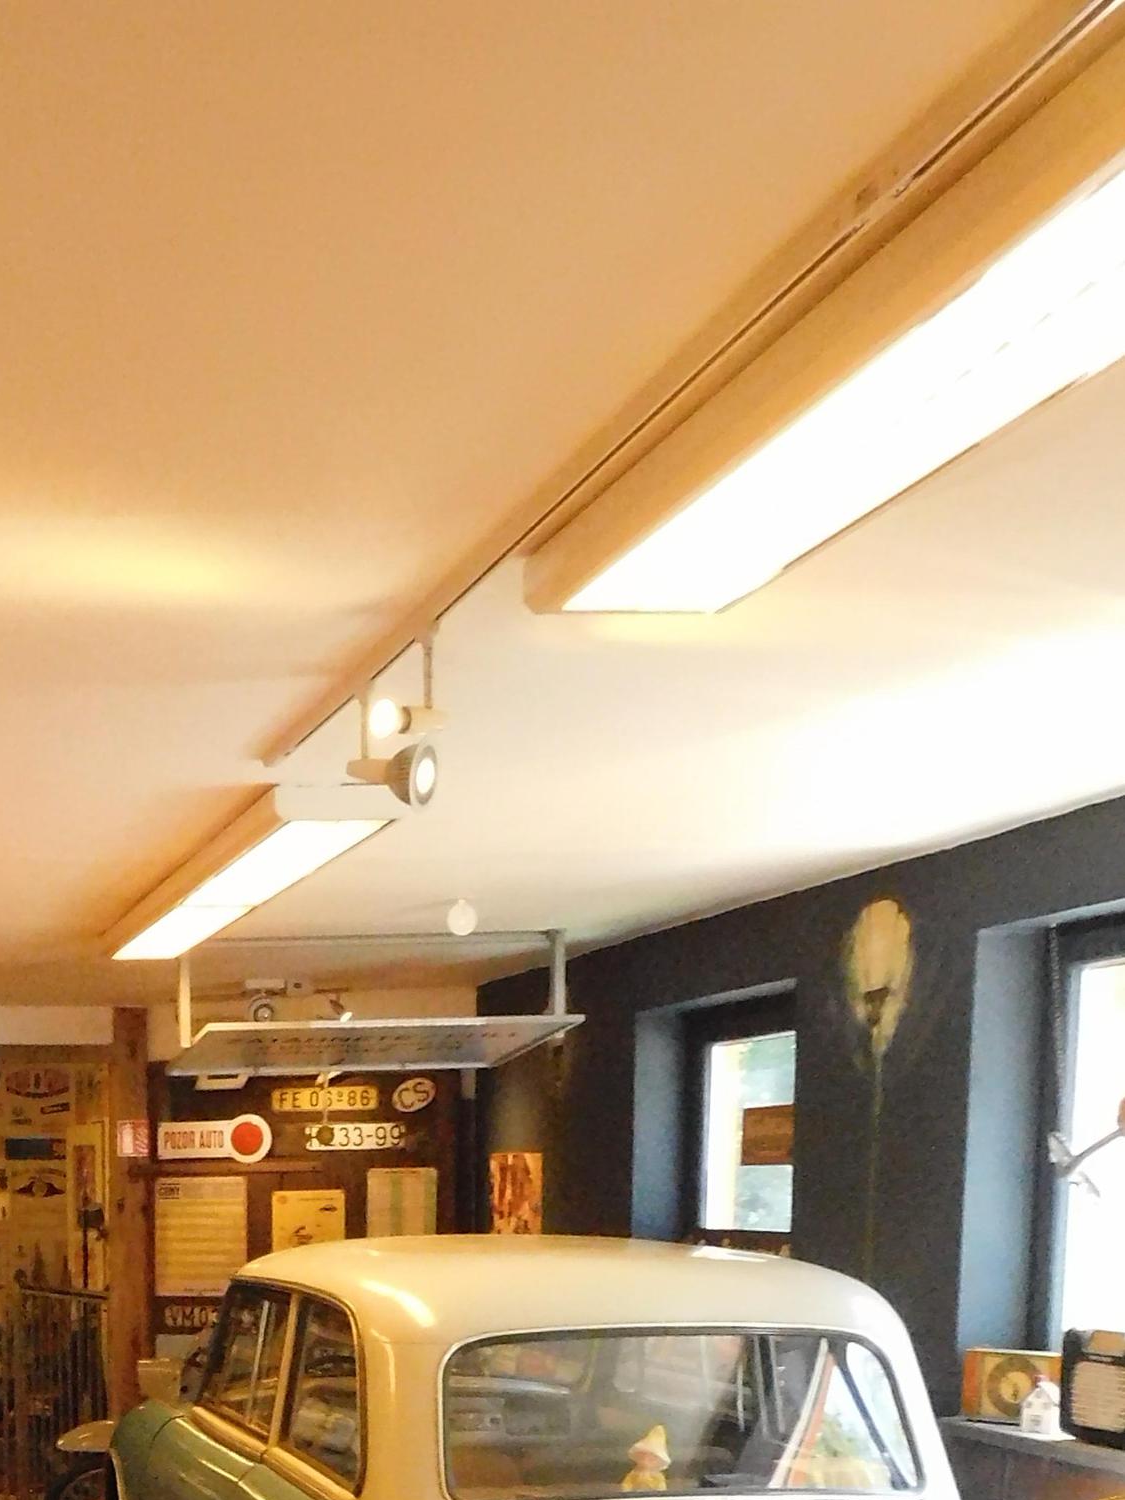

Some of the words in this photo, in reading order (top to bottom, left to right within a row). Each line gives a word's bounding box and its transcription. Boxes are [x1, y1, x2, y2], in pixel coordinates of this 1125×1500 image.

[278, 1091, 302, 1109] FE
[397, 1080, 429, 1109] CS
[163, 1130, 197, 1151] POZOR
[199, 1129, 225, 1149] AUTO
